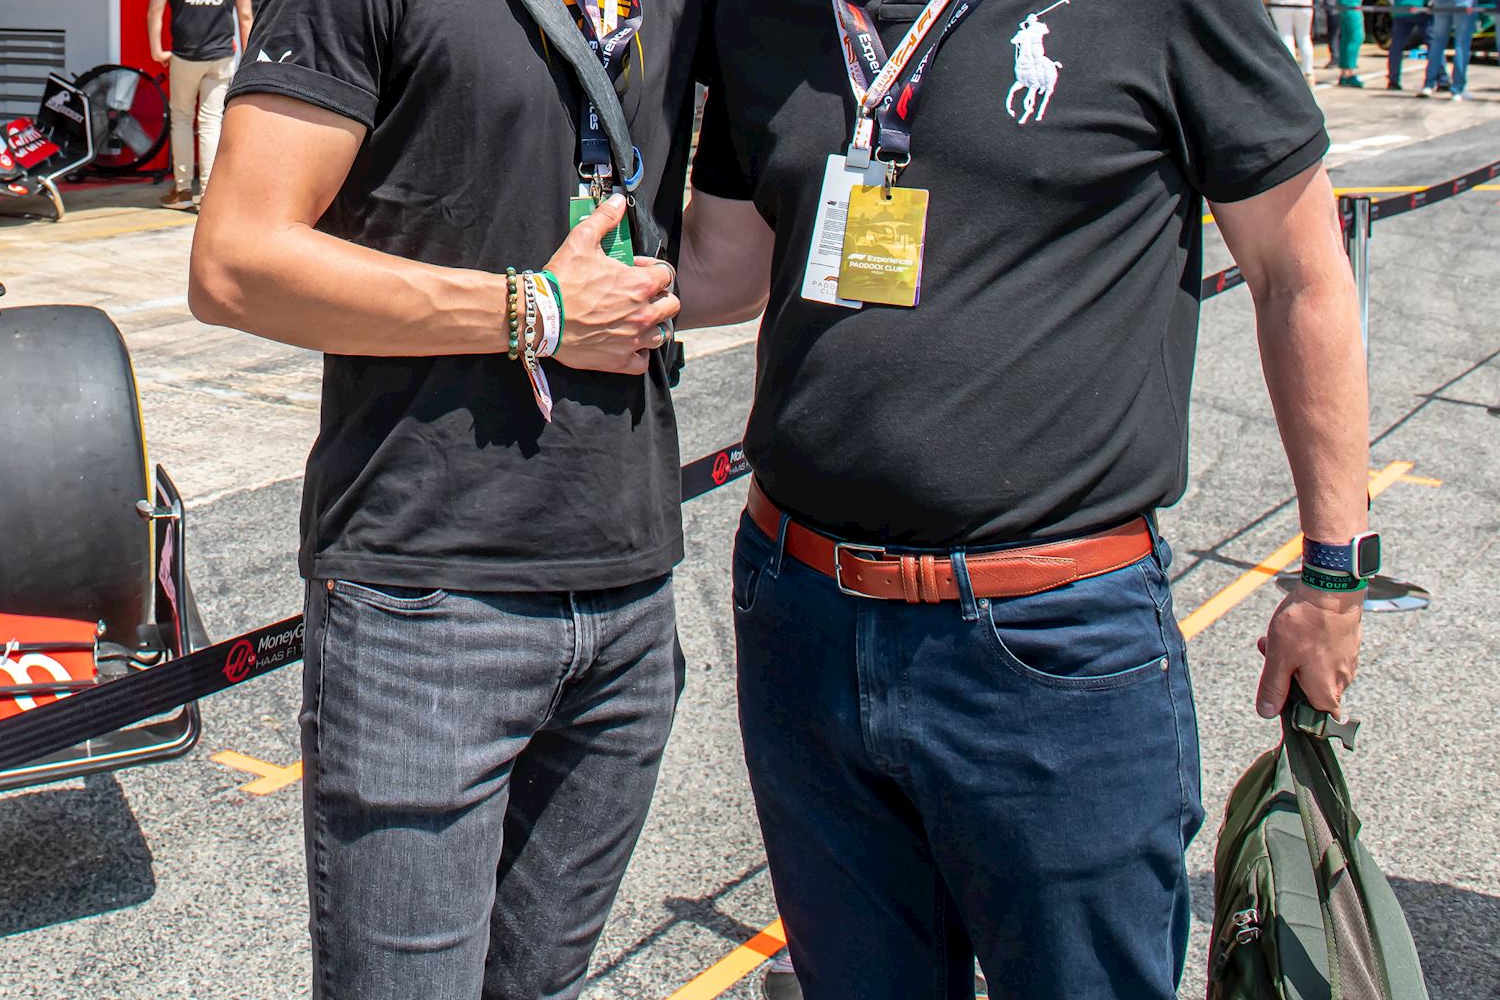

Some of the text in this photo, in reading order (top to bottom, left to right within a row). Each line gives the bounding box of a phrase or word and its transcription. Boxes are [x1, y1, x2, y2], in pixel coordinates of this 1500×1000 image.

[849, 260, 884, 271] PADDOCK
[867, 254, 914, 266] Experiences
[812, 281, 836, 290] PADD
[1320, 580, 1348, 589] TOUR
[257, 622, 304, 652] MoneyG
[255, 650, 284, 669] HAAS
